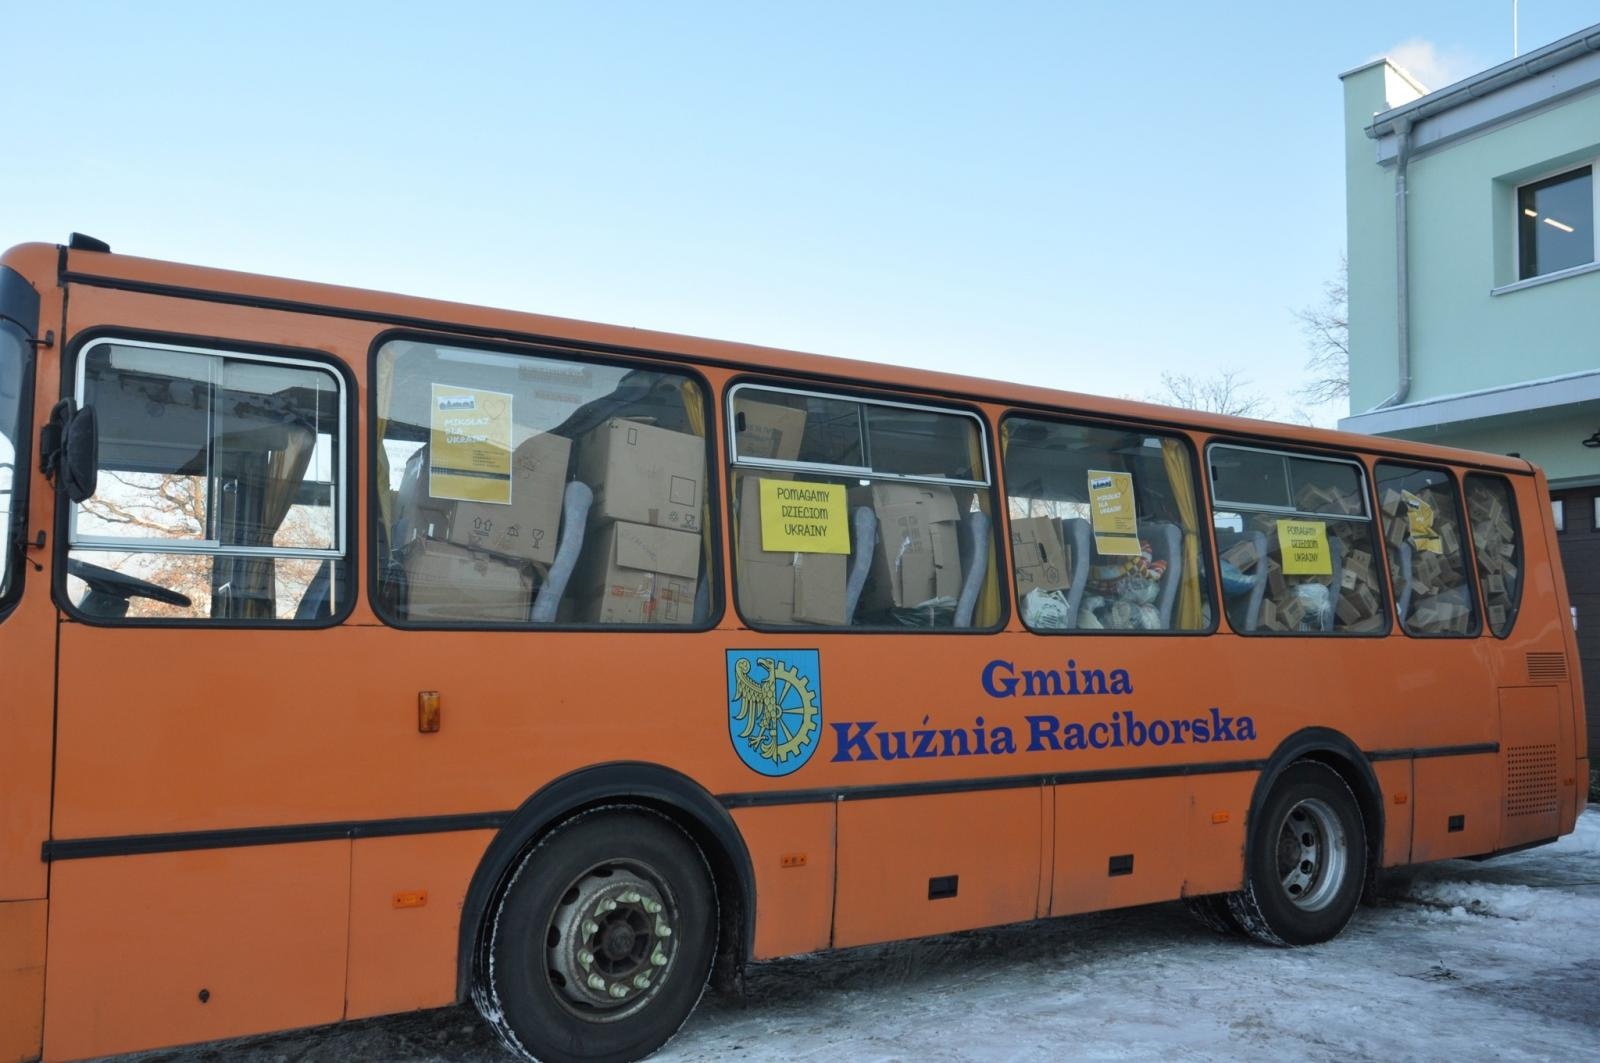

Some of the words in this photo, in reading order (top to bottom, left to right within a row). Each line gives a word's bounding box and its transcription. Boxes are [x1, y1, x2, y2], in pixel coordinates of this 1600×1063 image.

[777, 487, 830, 502] POMAGAMY
[782, 505, 828, 520] DZIECIOM
[784, 523, 828, 537] UKRAINY
[982, 660, 1133, 698] Gmina
[831, 715, 1017, 763] Kuźnia
[1027, 707, 1256, 752] Raciborska
